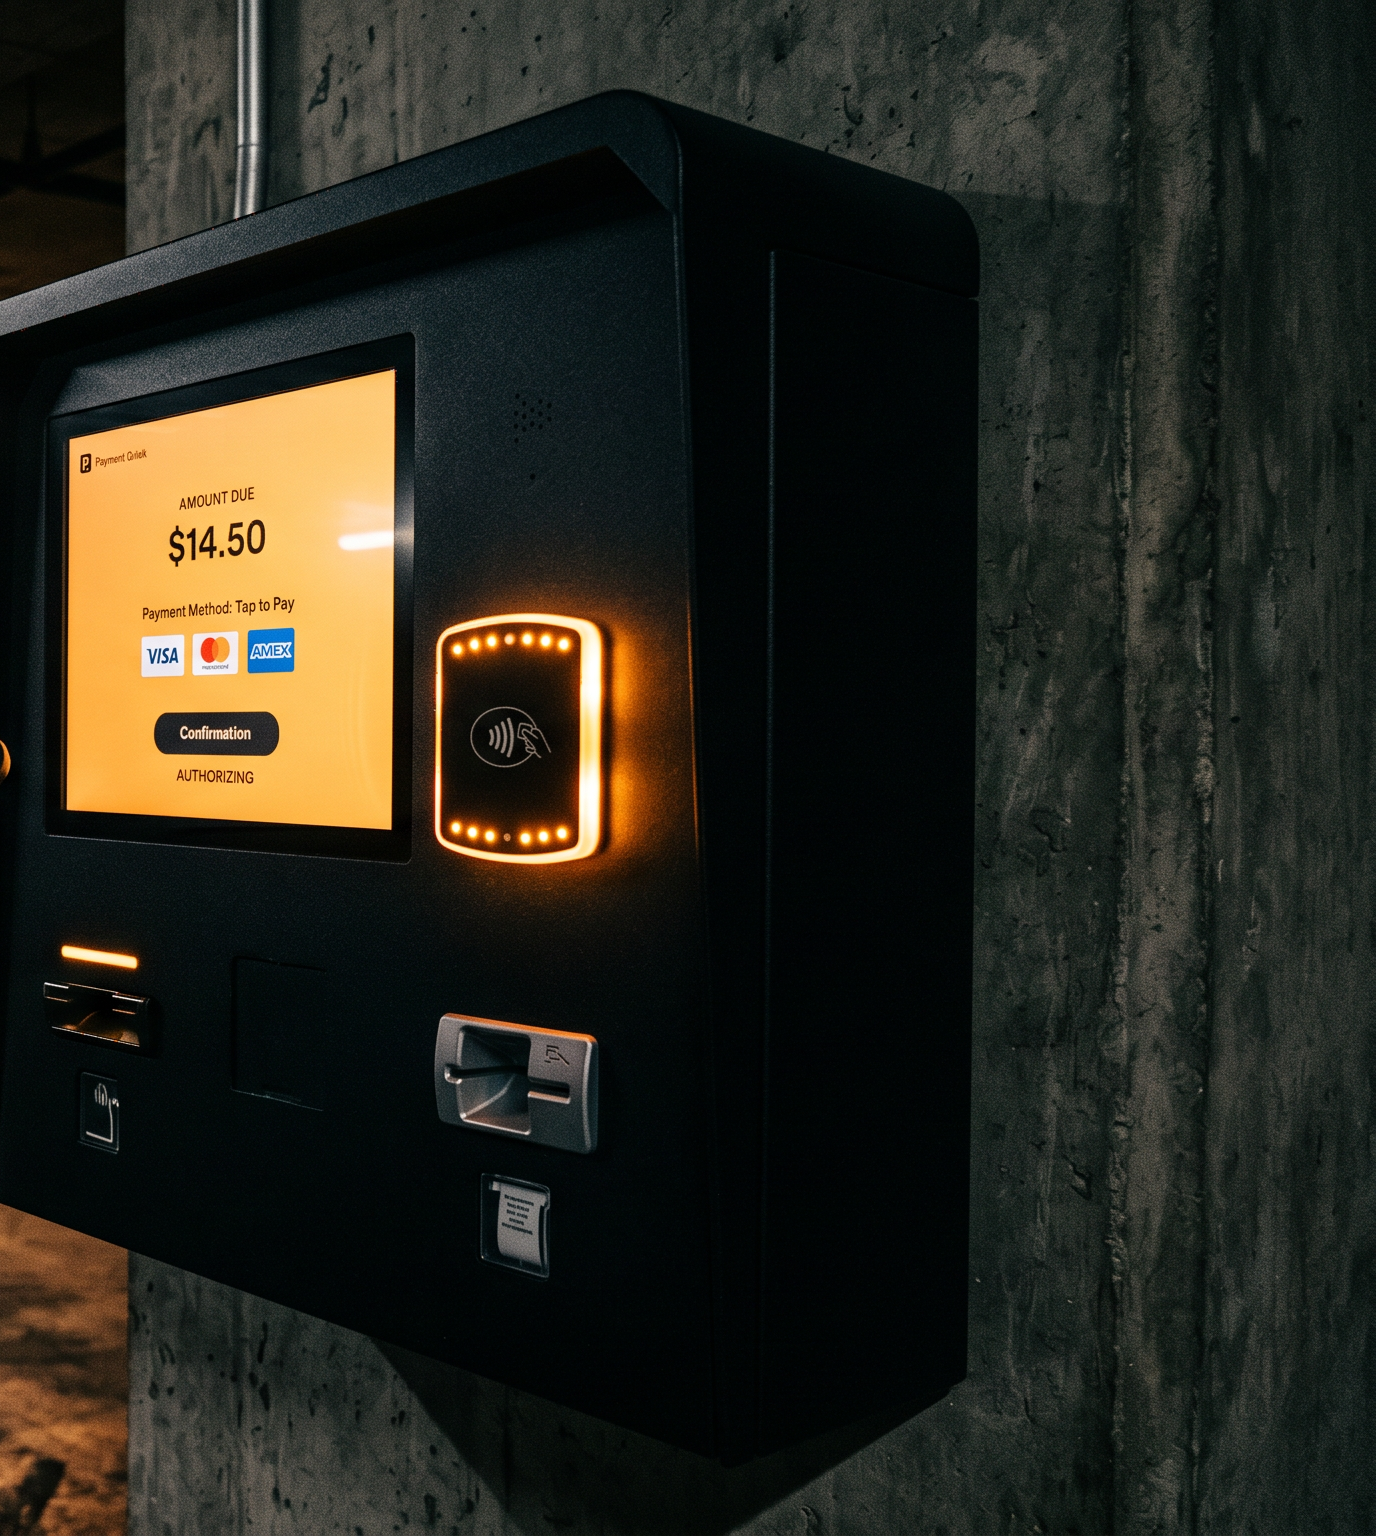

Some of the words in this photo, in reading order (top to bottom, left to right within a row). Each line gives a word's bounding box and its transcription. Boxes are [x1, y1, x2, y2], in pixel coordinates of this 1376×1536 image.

[95, 453, 125, 468] Payment
[179, 491, 228, 511] AMOUNT
[231, 487, 255, 503] DUE
[168, 519, 266, 567] $14.50
[142, 605, 186, 622] Payment
[188, 601, 233, 617] Method:
[235, 600, 256, 616] Tap
[259, 598, 271, 612] to
[274, 596, 295, 614] Pay
[146, 647, 179, 664] VISA
[250, 642, 292, 660] AMEX
[179, 725, 252, 740] Confirmation
[176, 769, 254, 784] AUTHORIZING
